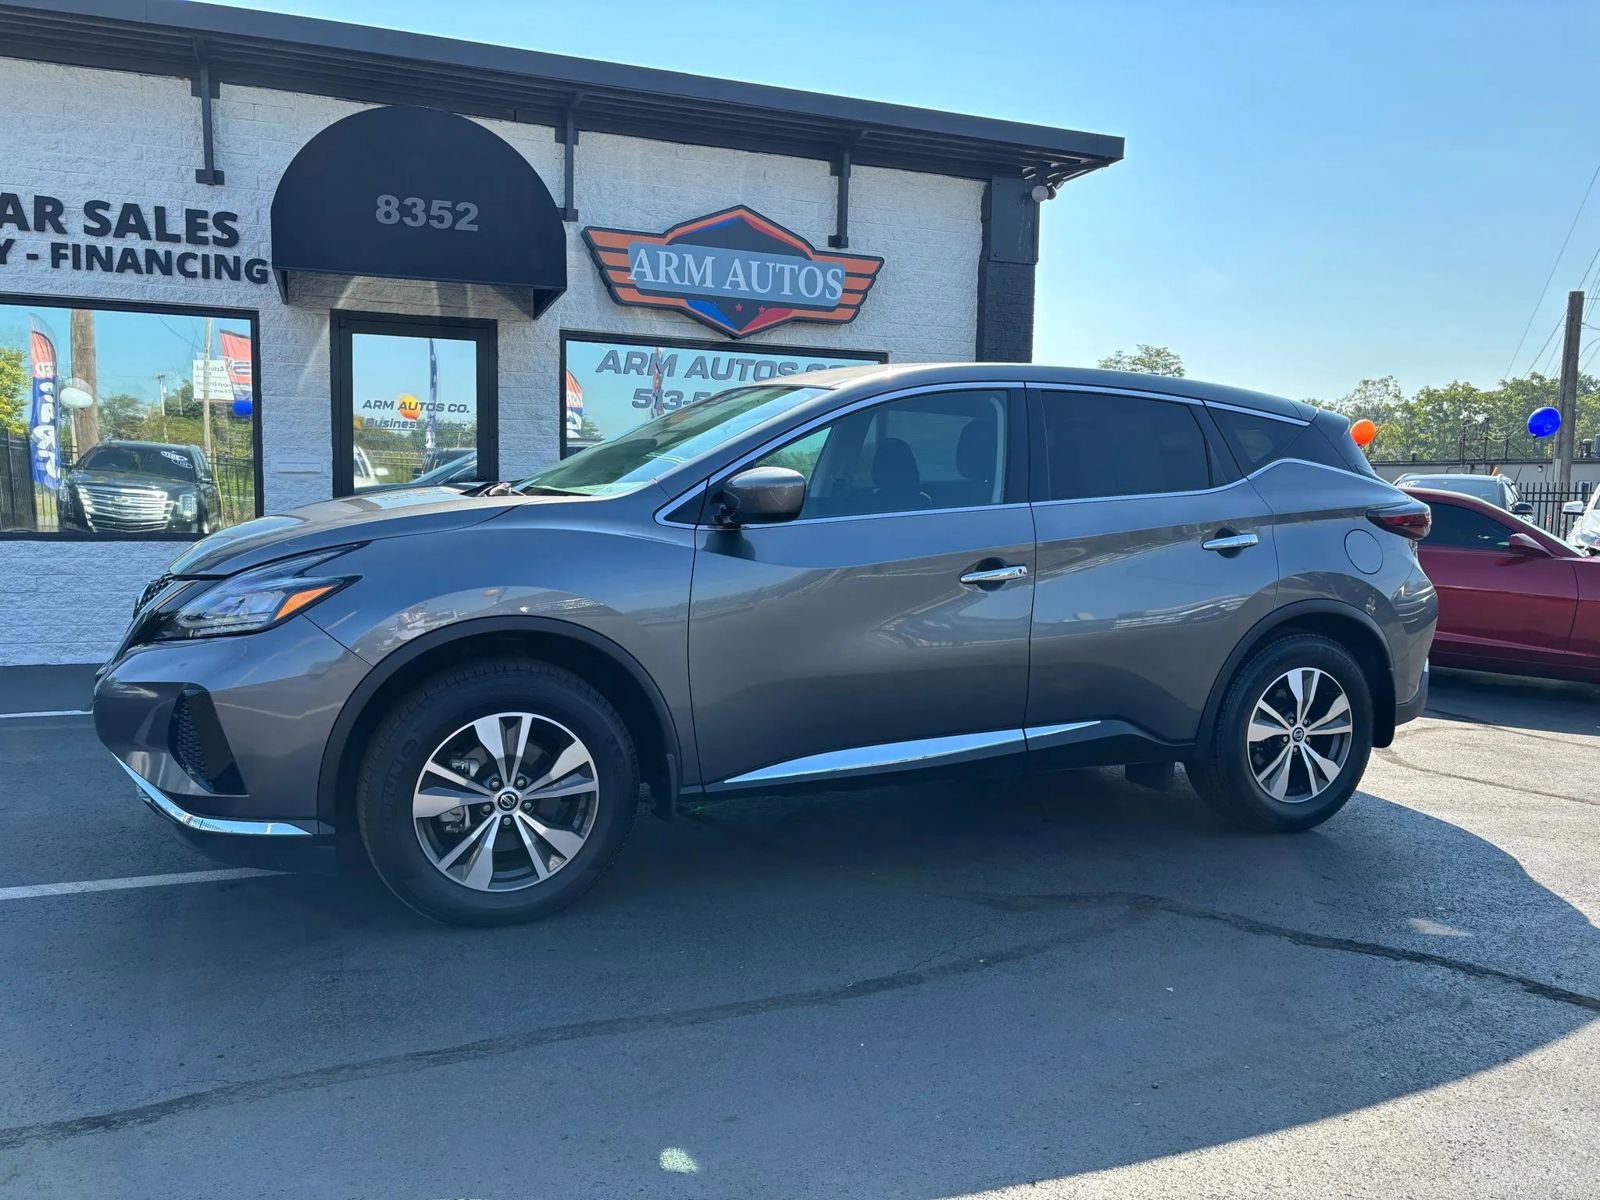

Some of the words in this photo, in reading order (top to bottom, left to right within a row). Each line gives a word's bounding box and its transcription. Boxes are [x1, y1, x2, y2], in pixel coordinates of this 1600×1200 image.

[83, 200, 239, 247] SALES
[375, 194, 479, 231] 8352
[50, 242, 268, 284] FINANCING
[627, 248, 715, 288] ARM
[722, 258, 843, 300] AUTOS
[595, 349, 678, 378] ARM
[684, 355, 798, 383] AUTOS
[362, 399, 395, 411] ARM
[397, 401, 445, 413] AUTOS
[447, 403, 470, 414] CO.
[366, 417, 423, 429] Business
